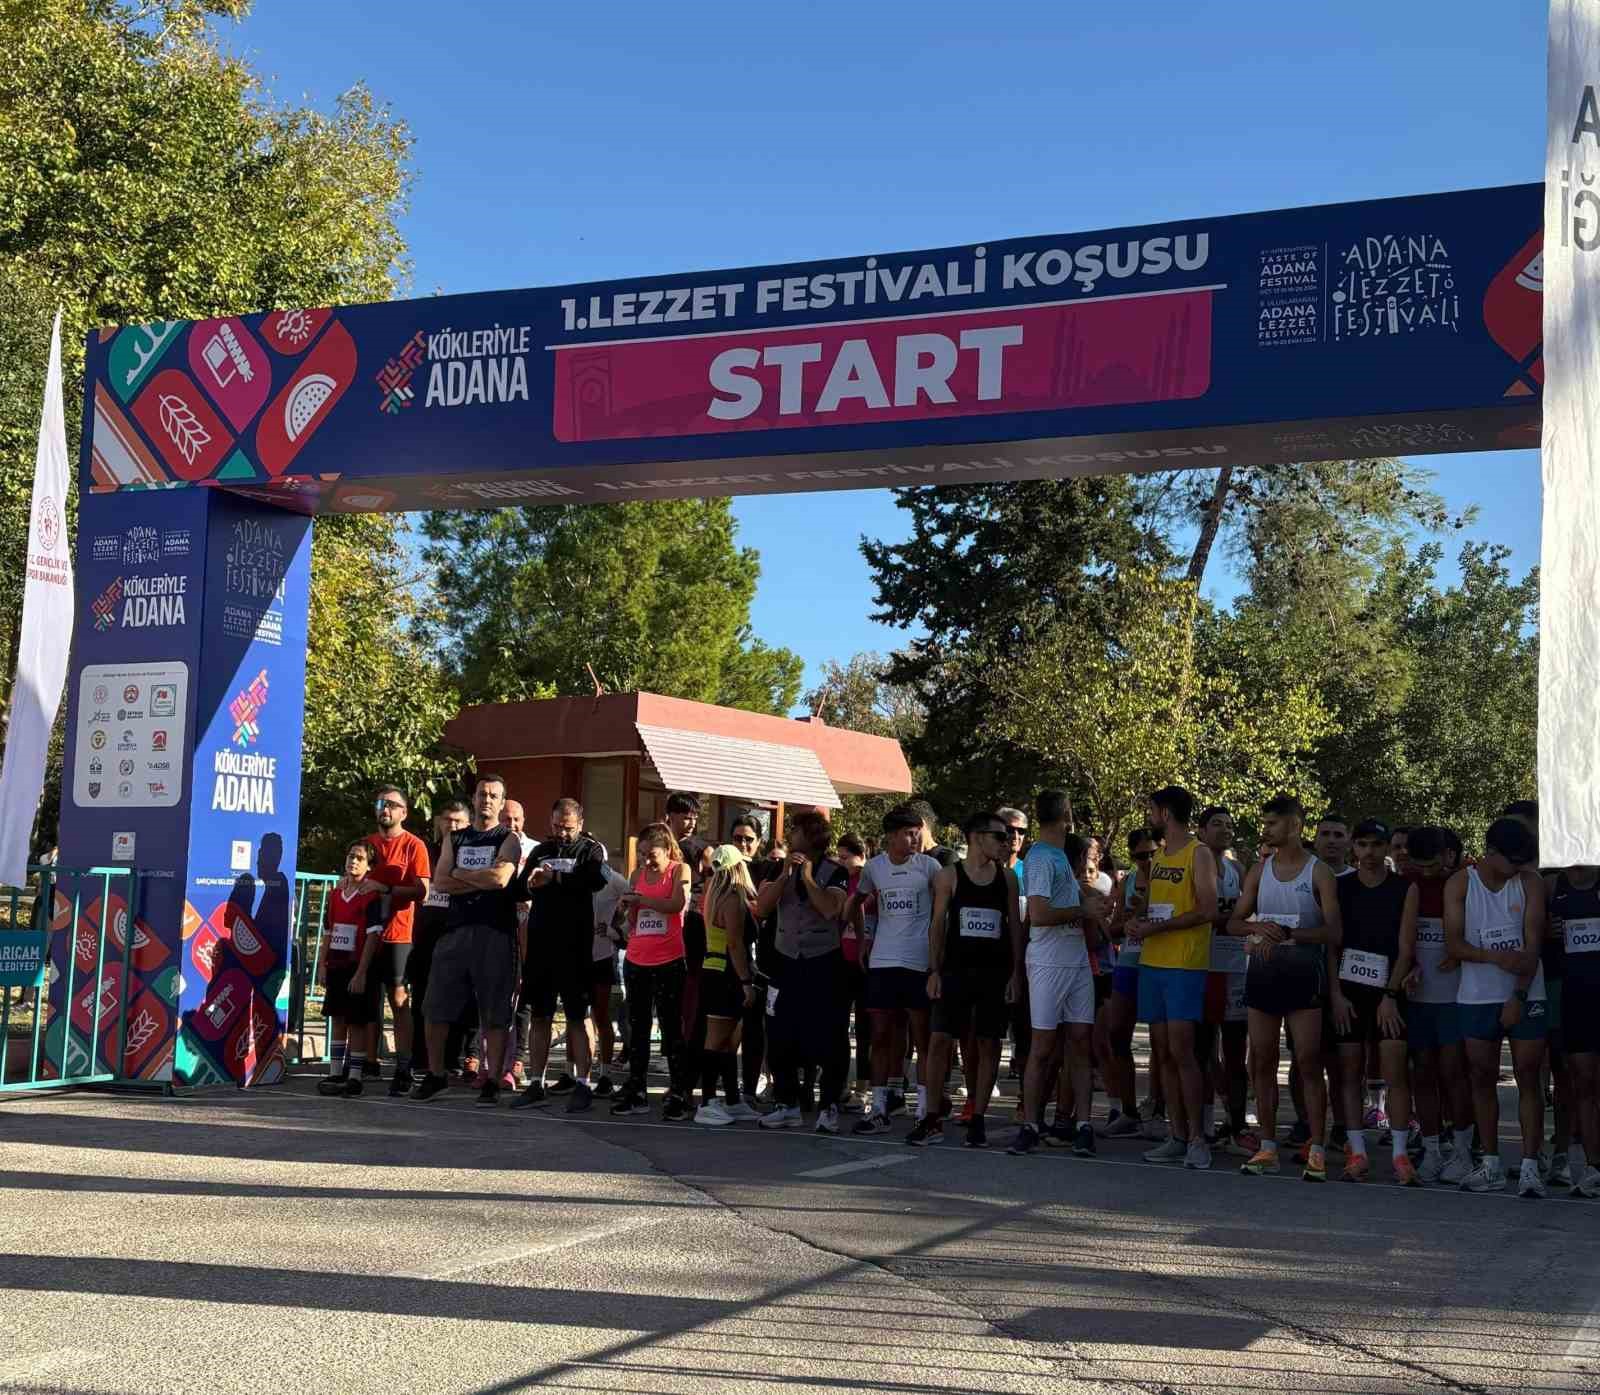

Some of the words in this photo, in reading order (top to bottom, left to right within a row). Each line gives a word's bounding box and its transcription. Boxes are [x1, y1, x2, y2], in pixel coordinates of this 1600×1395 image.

[1261, 254, 1296, 263] TASTE
[1303, 251, 1319, 260] OF
[1345, 235, 1448, 270] ADANA
[1261, 260, 1318, 276] ADANA
[561, 283, 744, 330] 1.LEZZET
[756, 247, 986, 313] FESTİVALİ
[1003, 232, 1210, 293] KOŞUSU
[1260, 274, 1317, 287] FESTIVAL
[1349, 268, 1440, 303] LEZZET
[1260, 304, 1316, 319] ADANA
[1259, 316, 1316, 330] LEZZET
[428, 323, 531, 360] KÖKLERİYLE
[707, 325, 1024, 421] START
[425, 357, 529, 407] ADANA
[165, 538, 190, 546] ADANA
[124, 573, 187, 596] KÖKLERİYLE
[122, 595, 186, 628] ADANA
[215, 748, 277, 779] KÖKLERİYLE
[212, 776, 275, 815] ADANA
[463, 857, 487, 866] 0002
[887, 900, 913, 910] 0006
[639, 919, 664, 930] 0026
[967, 920, 995, 932] 0029
[0, 945, 40, 961] RIÇAM
[1351, 964, 1379, 979] 0015
